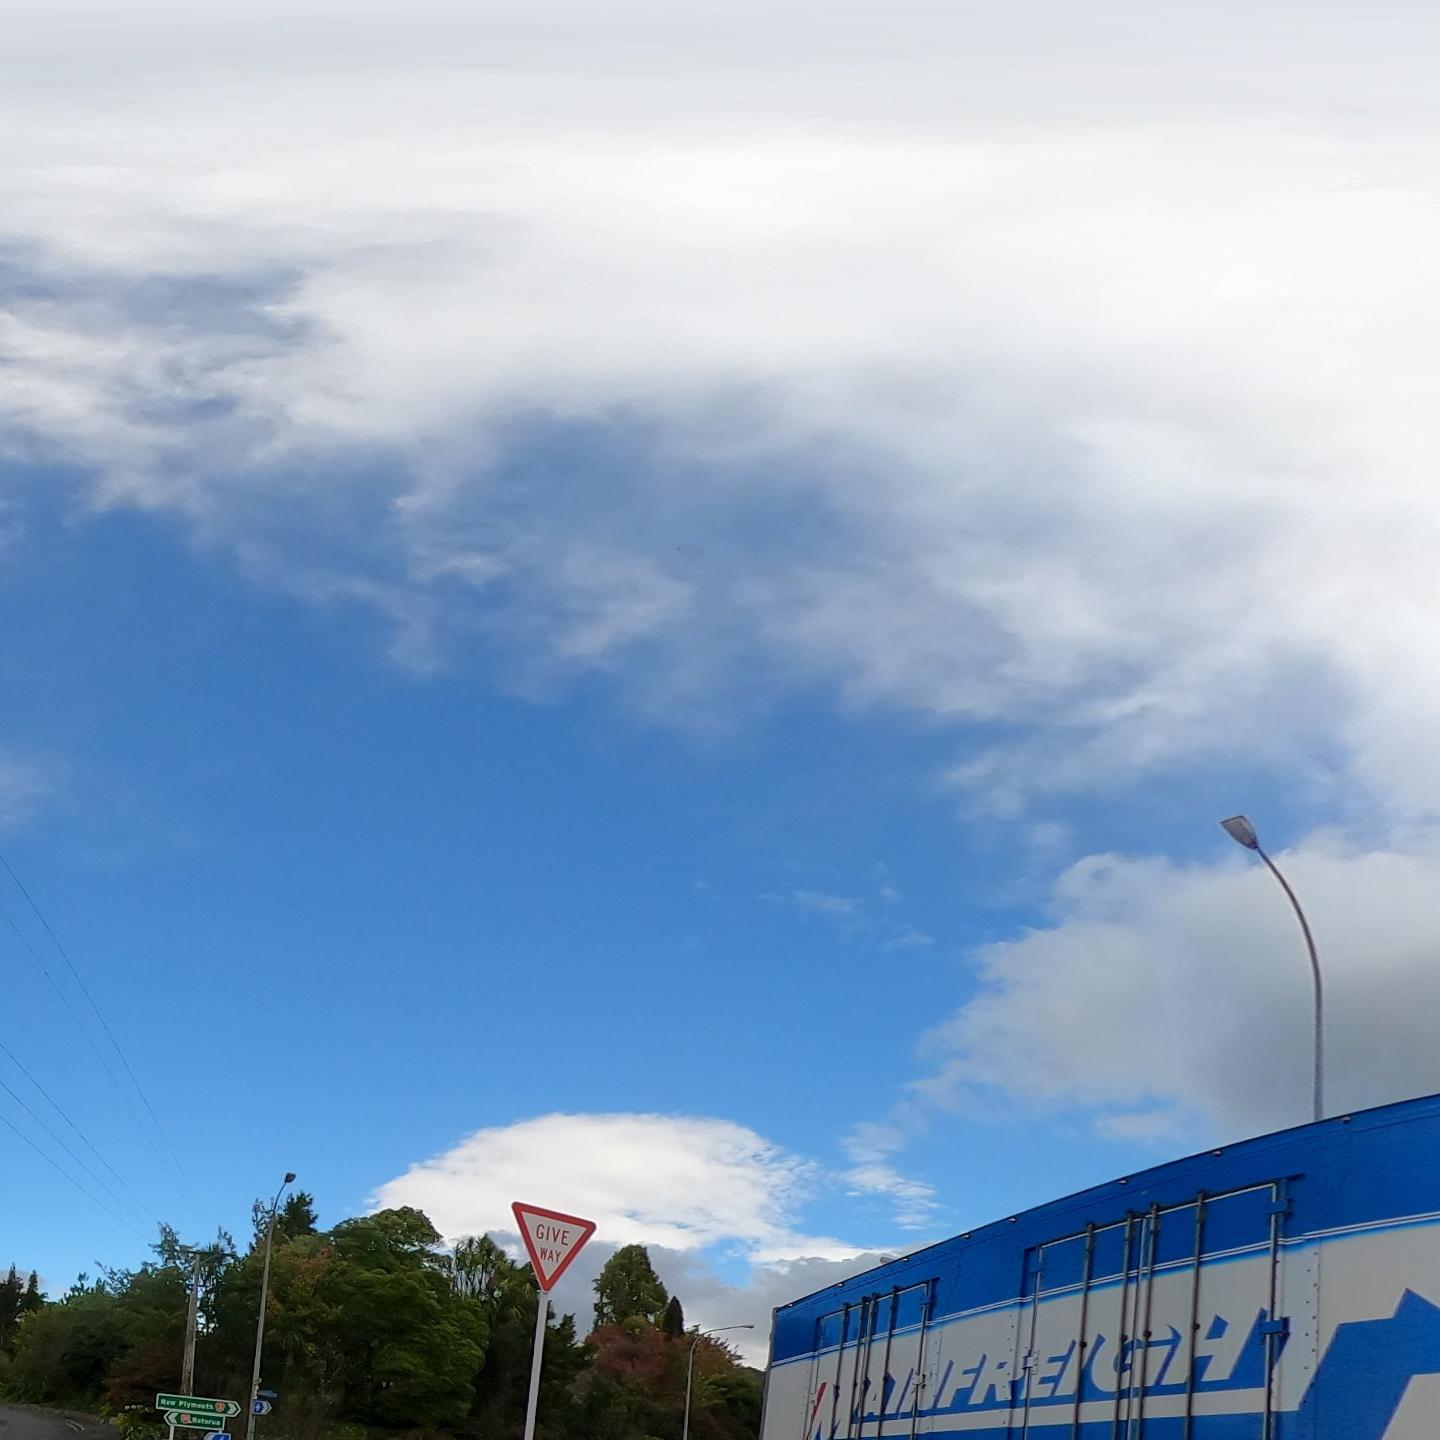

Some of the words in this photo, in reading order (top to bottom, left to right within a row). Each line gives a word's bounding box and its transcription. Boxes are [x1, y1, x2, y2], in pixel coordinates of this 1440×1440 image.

[536, 1223, 570, 1246] GIVE
[540, 1247, 562, 1263] WAY
[160, 1398, 176, 1406] New
[178, 1400, 214, 1410] Plymouth
